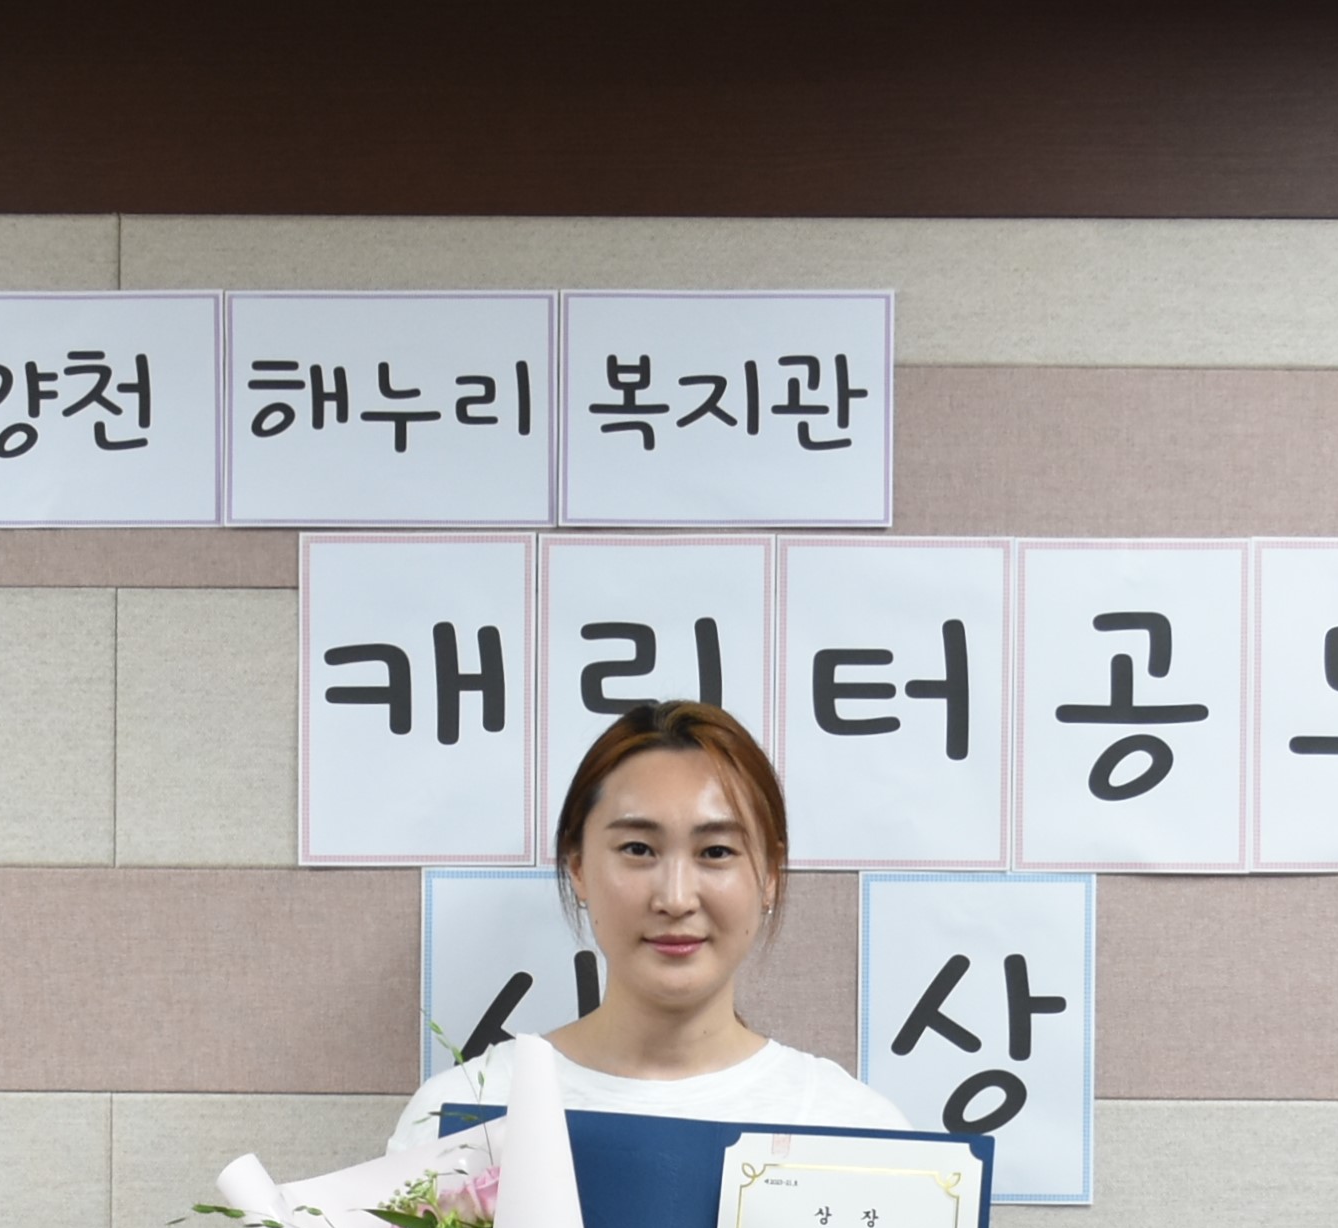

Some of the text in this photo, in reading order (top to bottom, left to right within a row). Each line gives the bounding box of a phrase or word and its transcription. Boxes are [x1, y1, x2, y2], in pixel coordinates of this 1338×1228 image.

[246, 359, 532, 453] 해누리
[588, 353, 868, 451] 복지관
[890, 953, 1067, 1134] 상
